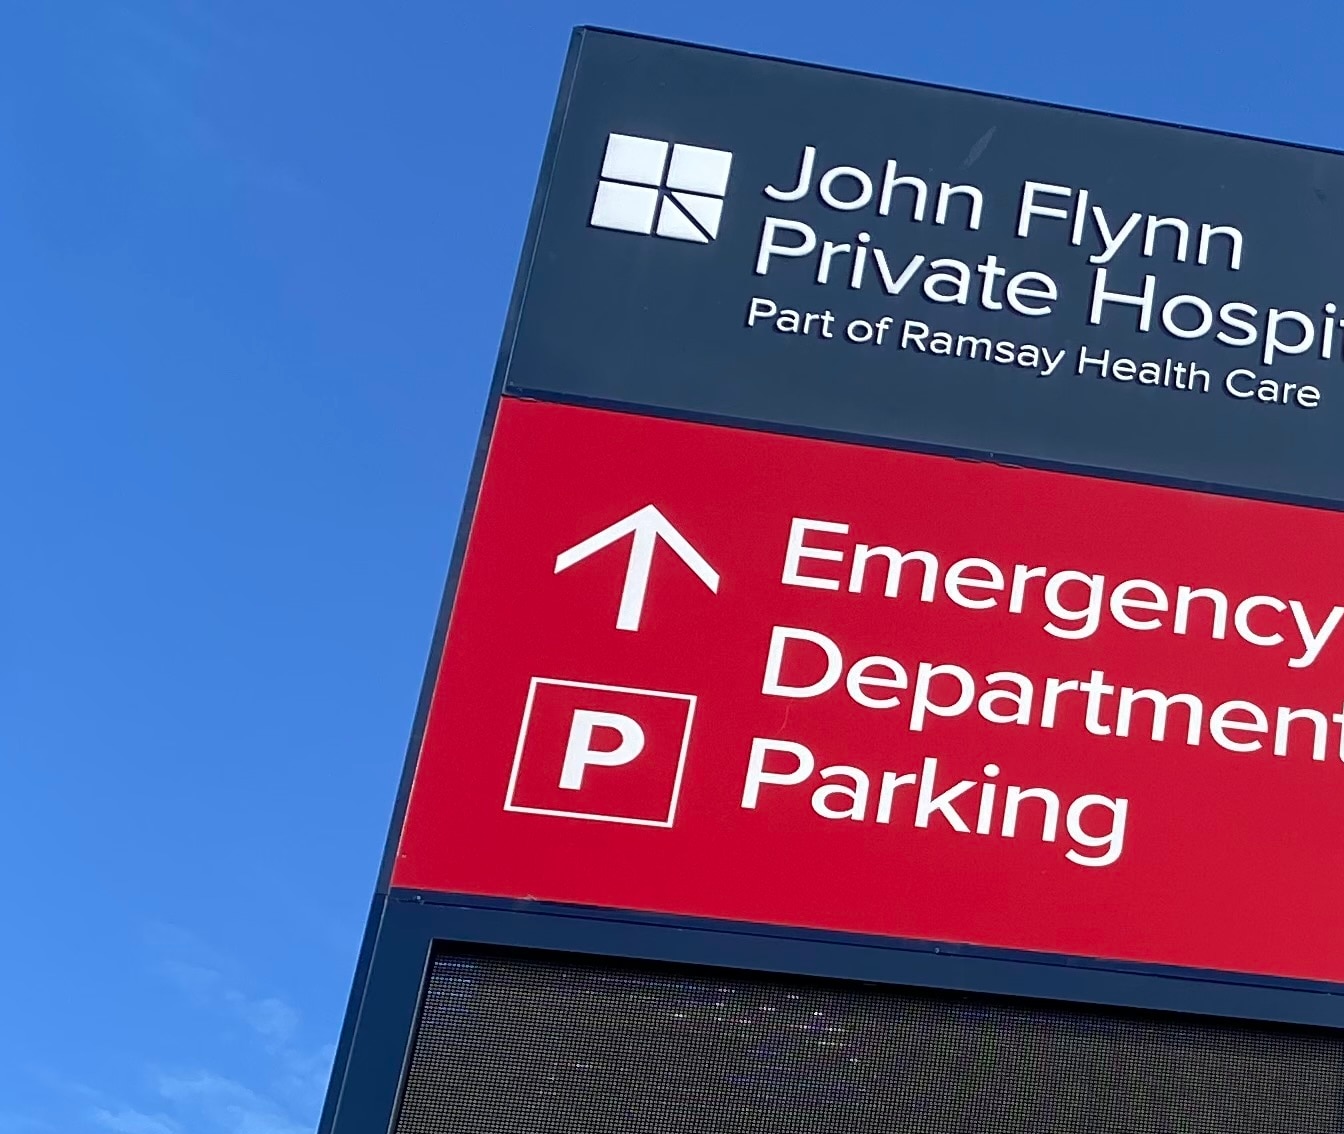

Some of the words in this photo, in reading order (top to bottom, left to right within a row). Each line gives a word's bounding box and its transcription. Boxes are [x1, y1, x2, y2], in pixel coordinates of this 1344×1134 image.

[764, 145, 983, 230] John
[1018, 180, 1243, 270] Flynn
[756, 216, 1058, 316] Private
[748, 297, 835, 338] Part
[847, 311, 892, 345] of
[901, 319, 1066, 376] Ramsay
[1078, 346, 1210, 392] Health
[1226, 368, 1321, 407] Care
[558, 709, 645, 791] P
[740, 737, 1129, 867] Parking
